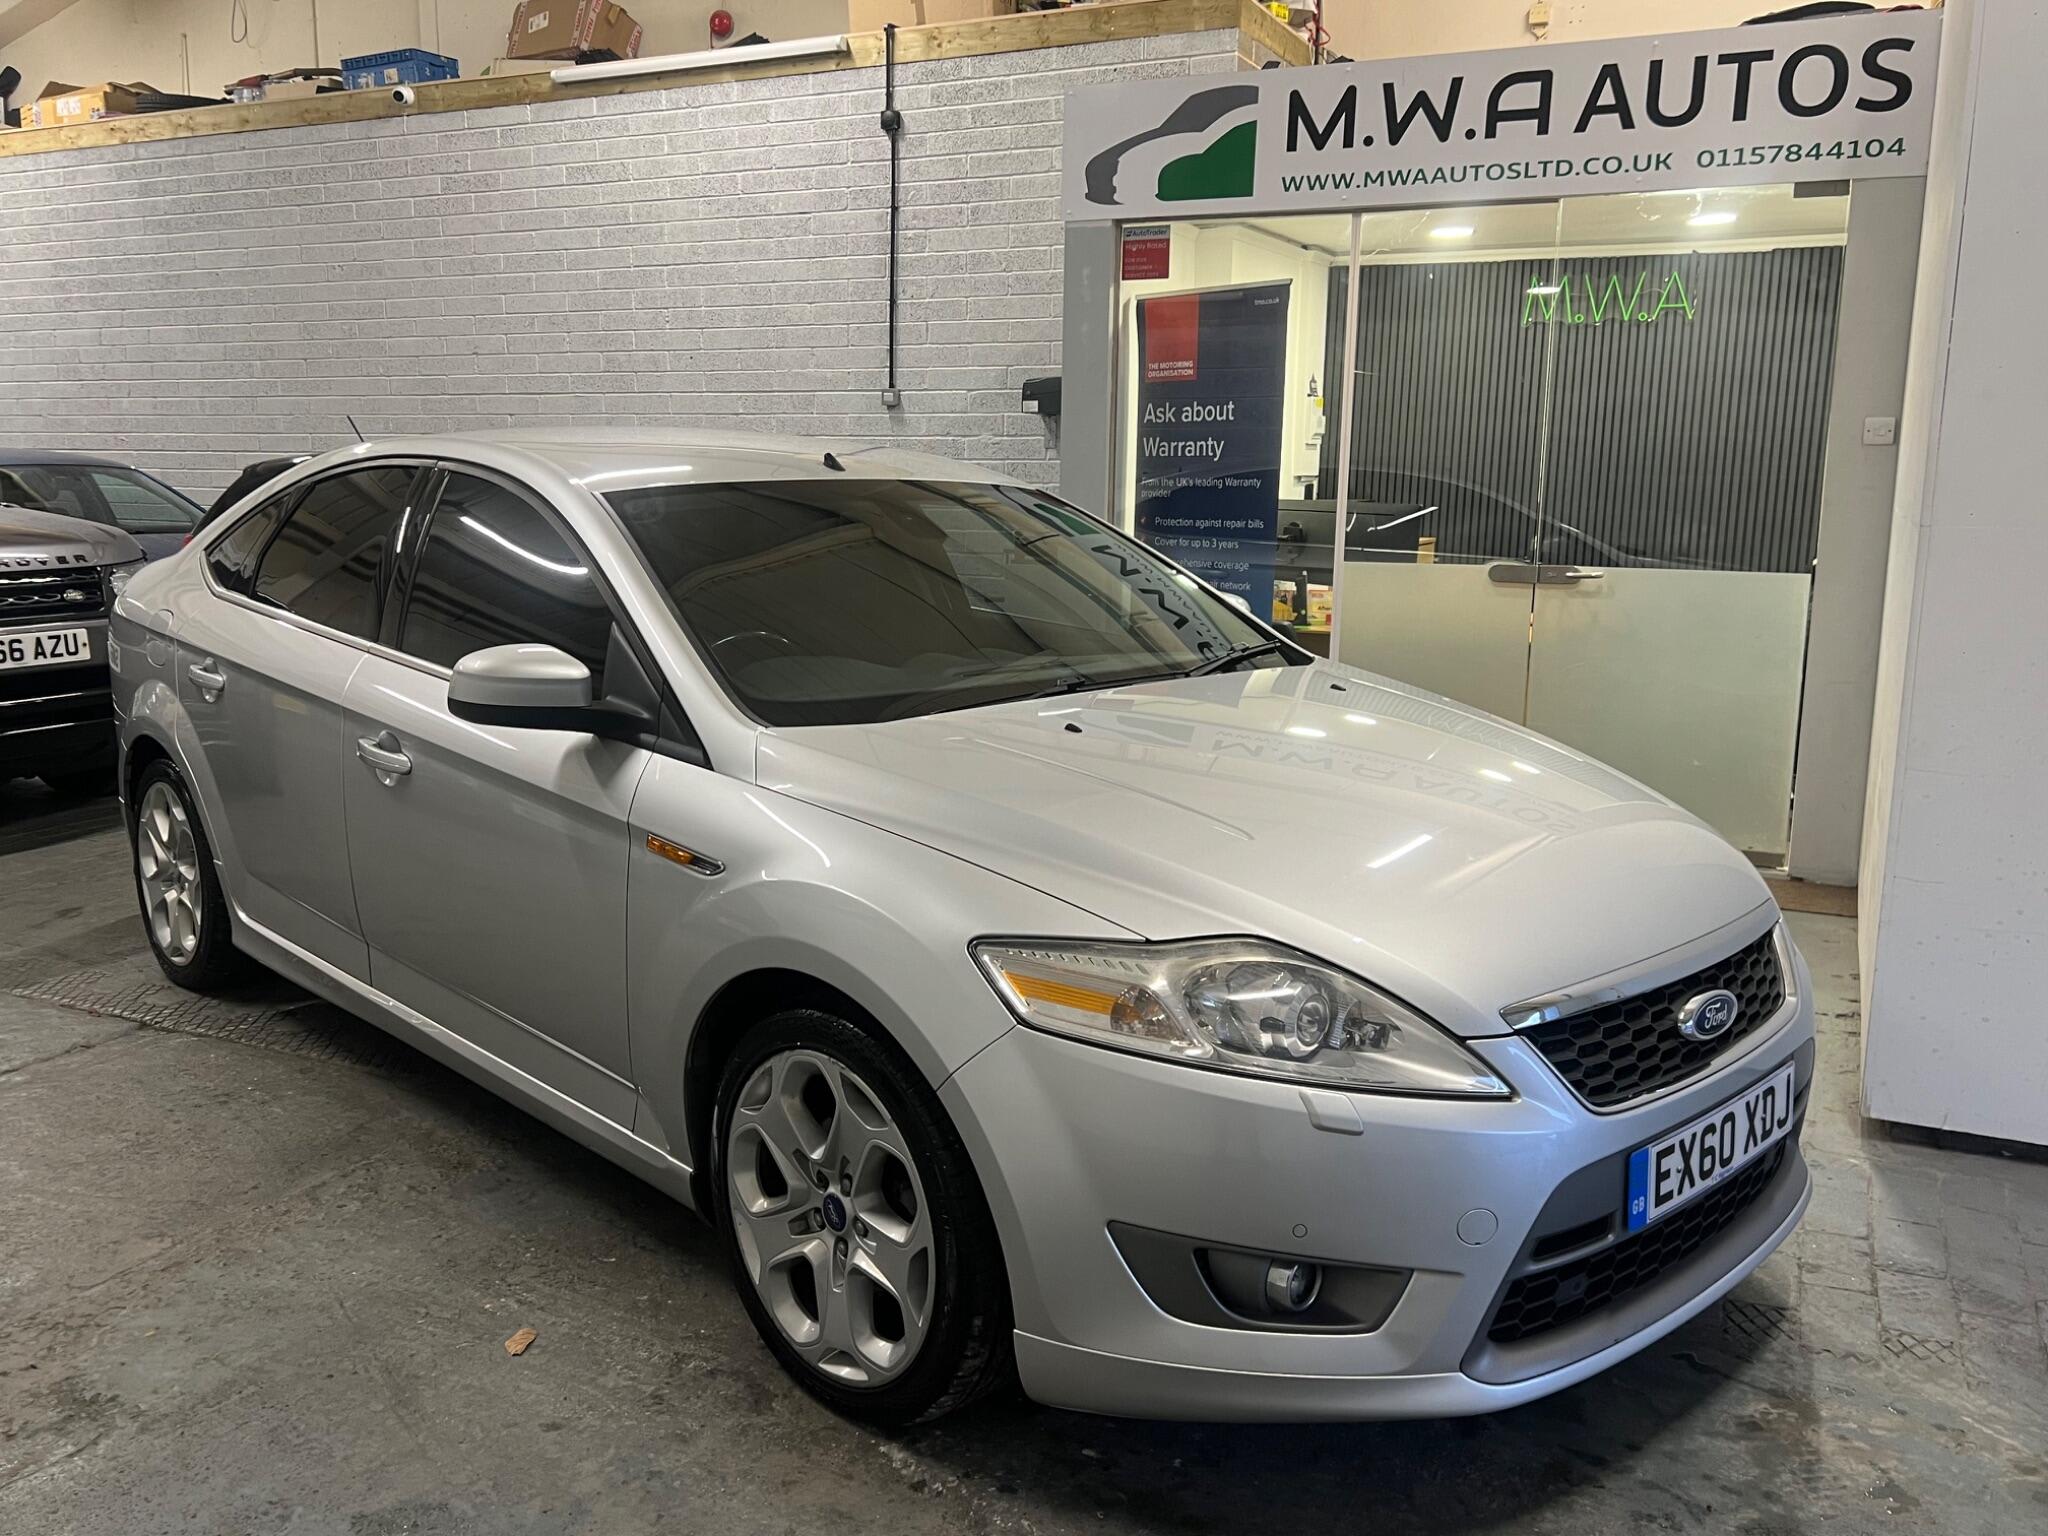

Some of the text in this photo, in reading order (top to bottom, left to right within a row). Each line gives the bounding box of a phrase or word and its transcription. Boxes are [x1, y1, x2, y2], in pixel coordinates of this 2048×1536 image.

[1286, 37, 1915, 152] M.W.A AUTOS
[1281, 137, 1906, 192] WWW.MWAAUTOSLTD.CO.UK 01157844104
[1523, 271, 1693, 325] M.W.A
[1147, 369, 1194, 378] ORGANISATION
[1148, 360, 1194, 370] THE MOTORING
[1143, 400, 1235, 424] Ask about
[1143, 436, 1225, 462] Warranty
[1141, 487, 1172, 499] provider
[1161, 475, 1174, 487] the
[1176, 476, 1194, 488] UK's
[1195, 477, 1223, 490] leading
[1225, 477, 1262, 490] Warranty
[1155, 516, 1265, 530] Protection against repair bills
[1154, 536, 1239, 550] Cover for up to 3 years
[1177, 558, 1250, 572] ehensive coverage
[1220, 580, 1252, 592] network
[34, 633, 80, 661] AZU
[1704, 1001, 1728, 1030] Ford
[1654, 1073, 1792, 1209] EX60 XDJ
[1632, 1195, 1645, 1216] GB
